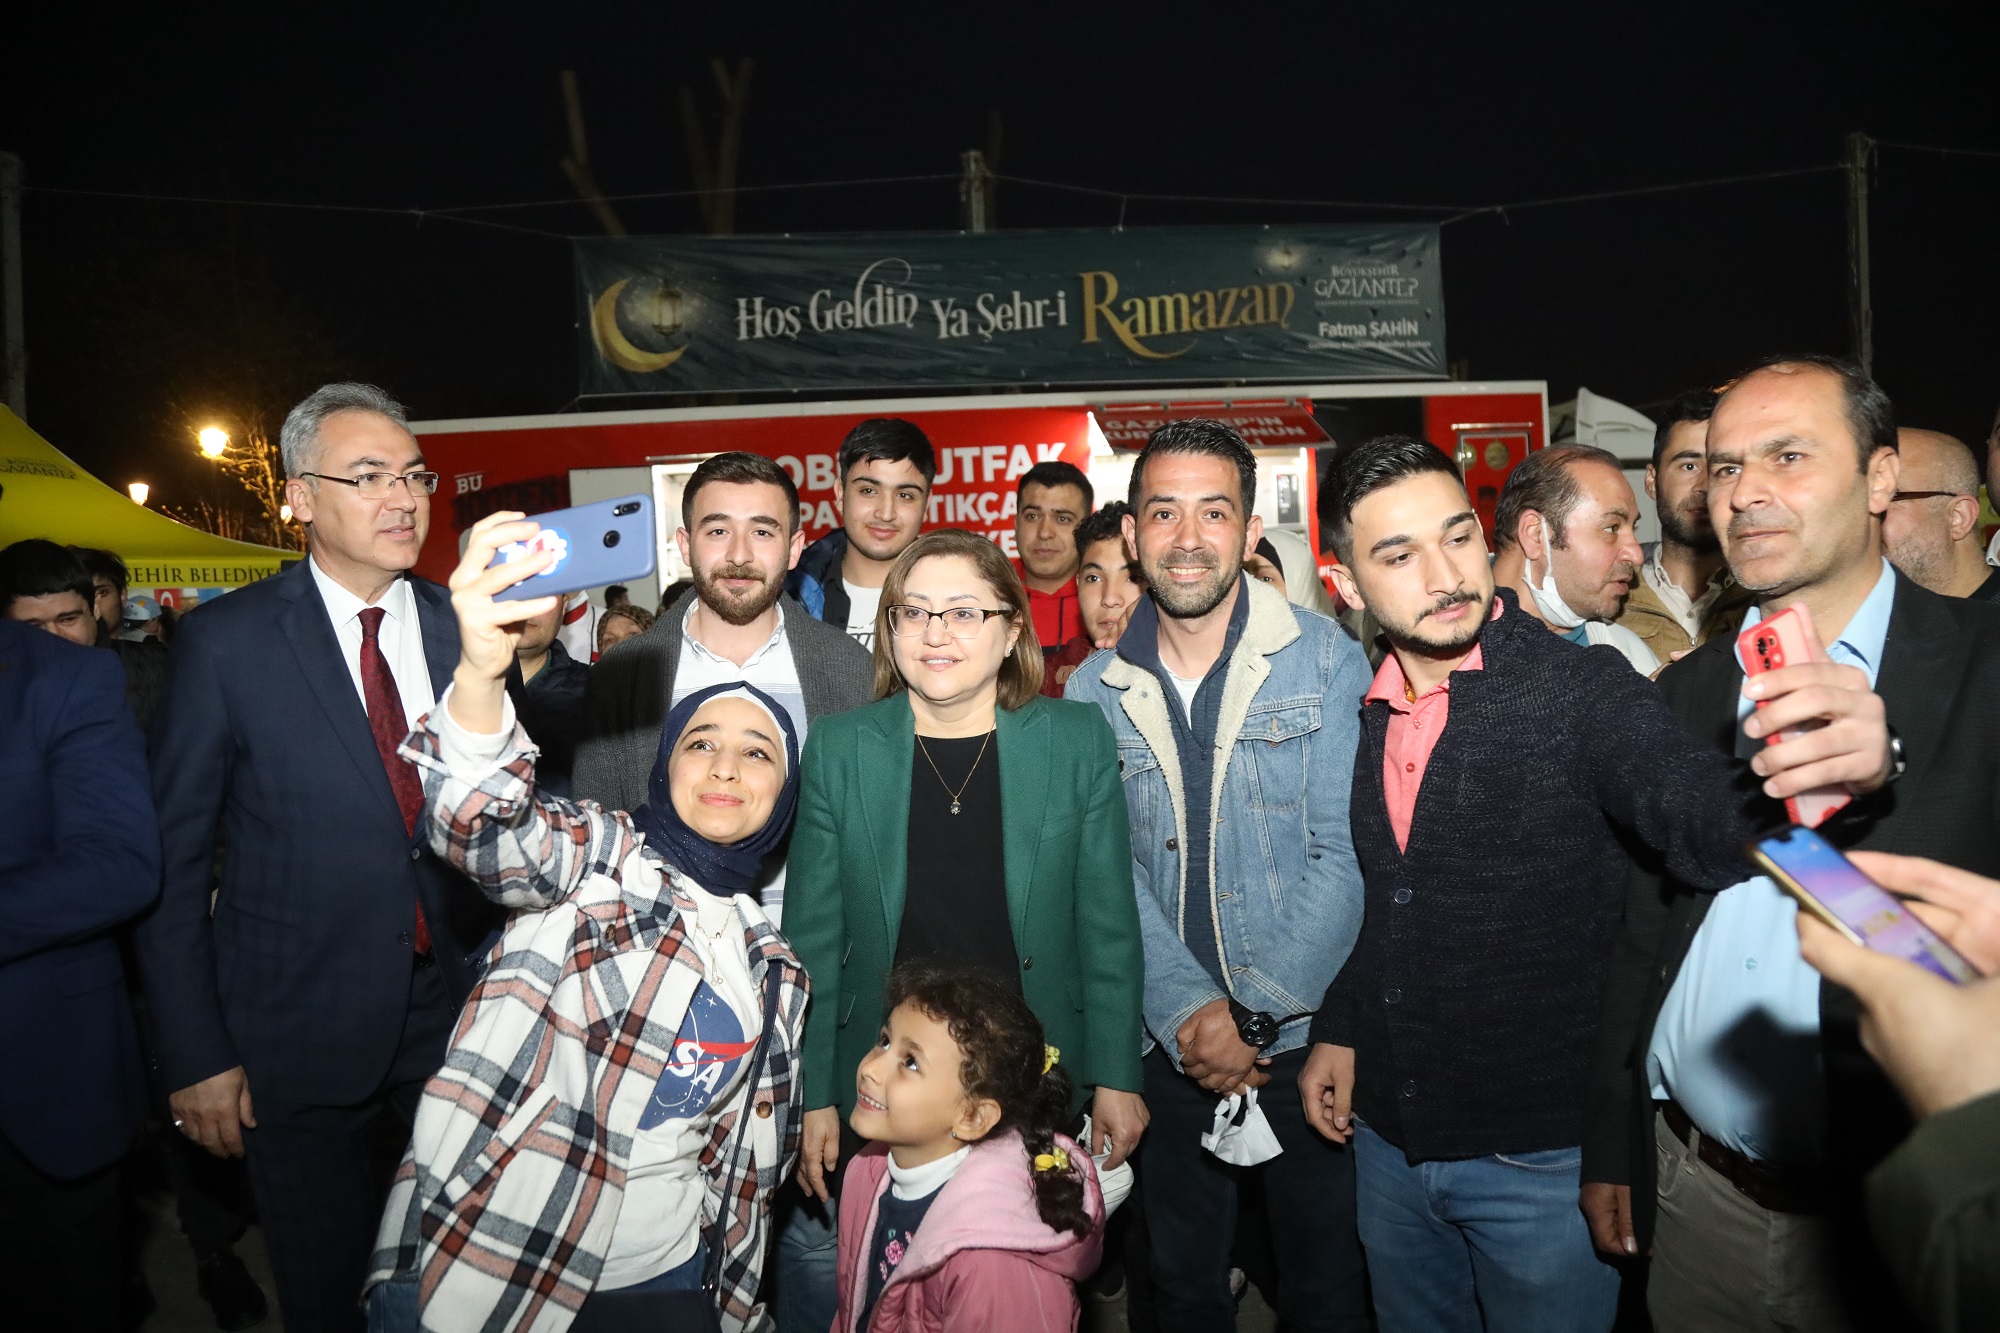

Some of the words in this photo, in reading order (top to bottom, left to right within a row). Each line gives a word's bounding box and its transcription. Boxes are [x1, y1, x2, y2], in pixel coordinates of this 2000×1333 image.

[809, 257, 919, 333] Geldin
[931, 297, 970, 339] Ya
[977, 290, 1068, 342] Şehr-i
[1079, 270, 1295, 359] Ramazan
[1318, 321, 1367, 338] Fatma
[1369, 317, 1419, 338] ŞAHİN
[666, 1041, 725, 1094] SA
